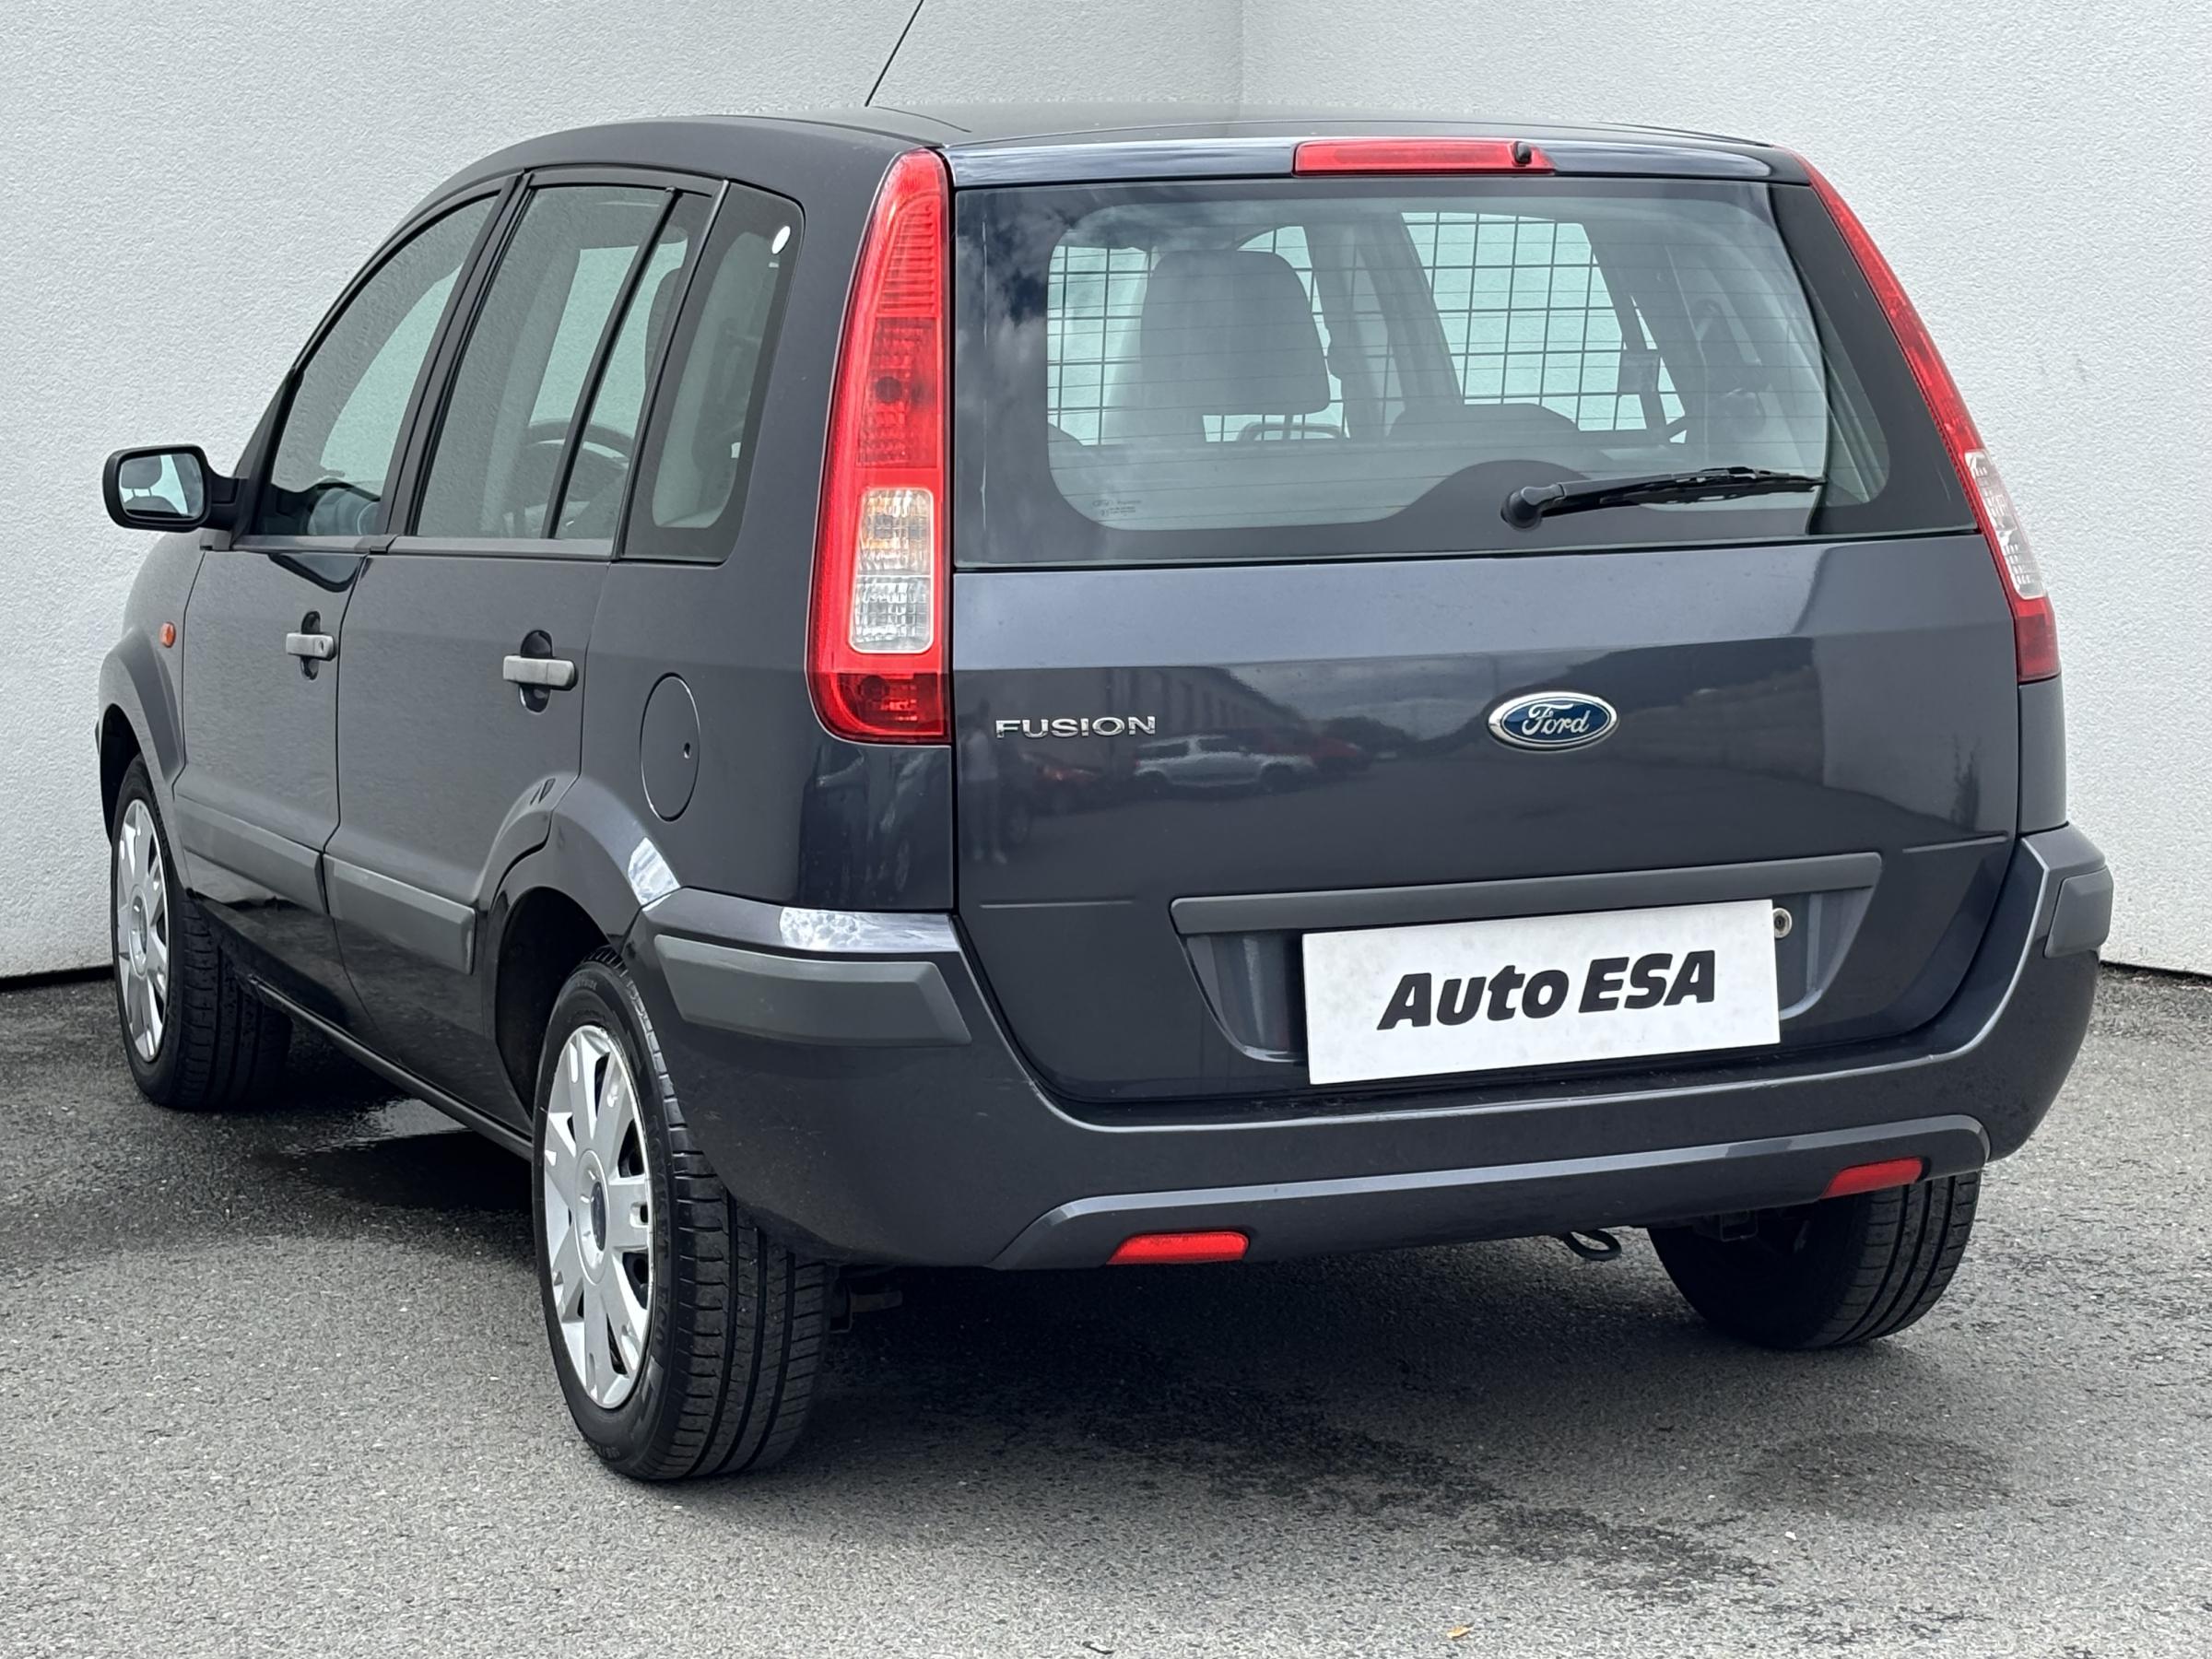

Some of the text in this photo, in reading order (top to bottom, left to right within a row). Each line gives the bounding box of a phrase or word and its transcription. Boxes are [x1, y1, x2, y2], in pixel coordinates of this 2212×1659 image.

[995, 715, 1156, 738] FUSION
[1522, 703, 1592, 735] Ford
[1377, 949, 1715, 1030] Auto ESA
